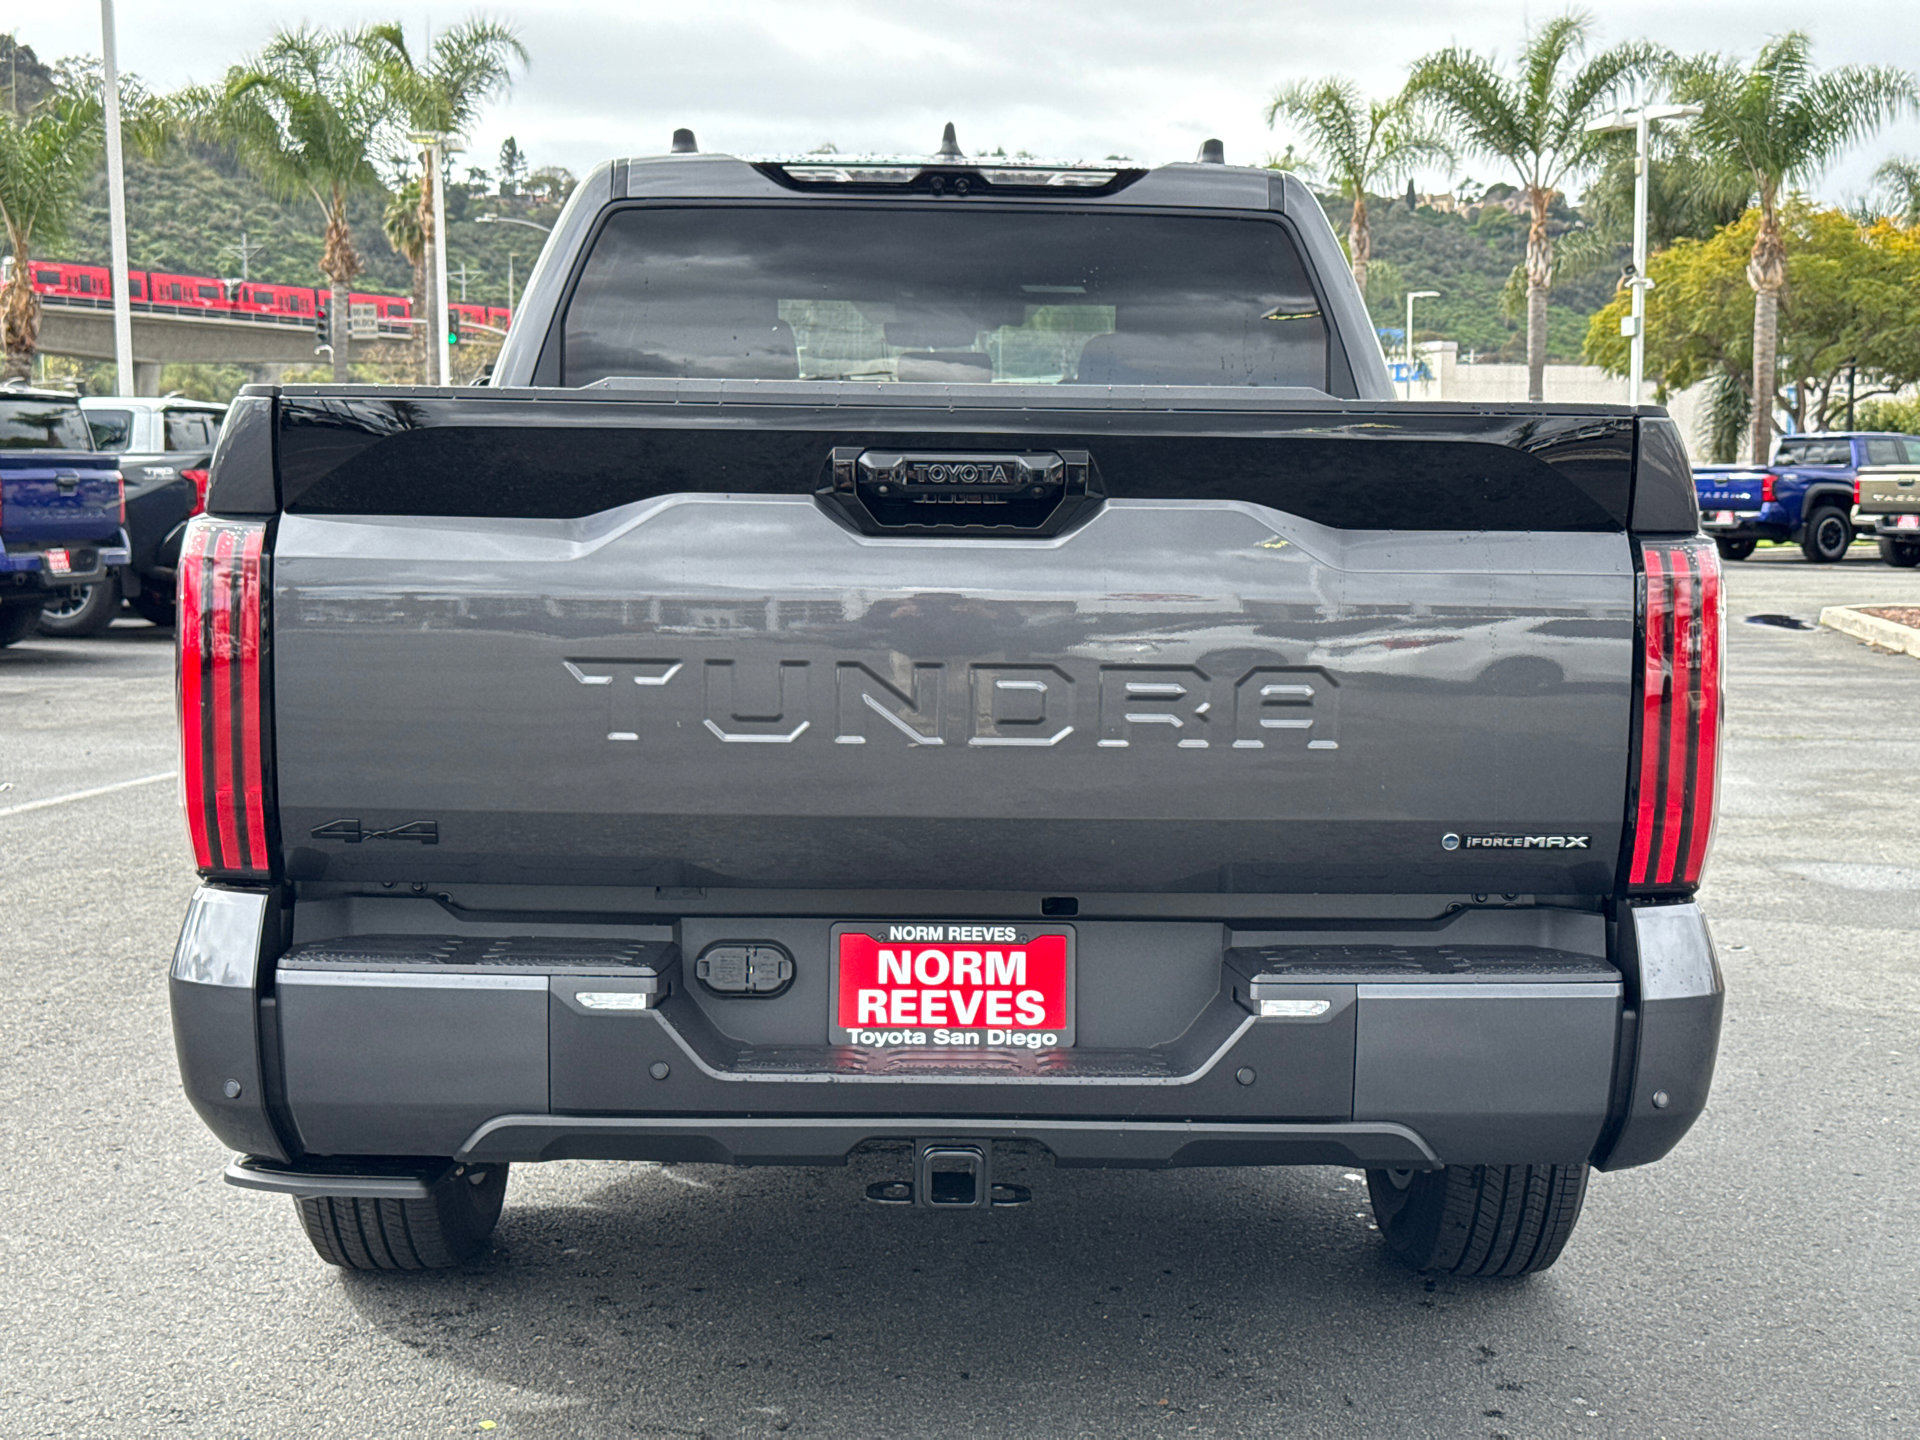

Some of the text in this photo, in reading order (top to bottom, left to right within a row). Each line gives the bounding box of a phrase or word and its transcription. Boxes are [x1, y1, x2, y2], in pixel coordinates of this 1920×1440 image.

[914, 463, 1008, 483] TOYOTA
[563, 656, 1341, 749] TUNDRA
[889, 926, 1017, 942] NORM REEVES
[877, 949, 1027, 986] NORM
[857, 988, 1047, 1026] REEVES
[846, 1028, 1058, 1049] Toyota San Diego
